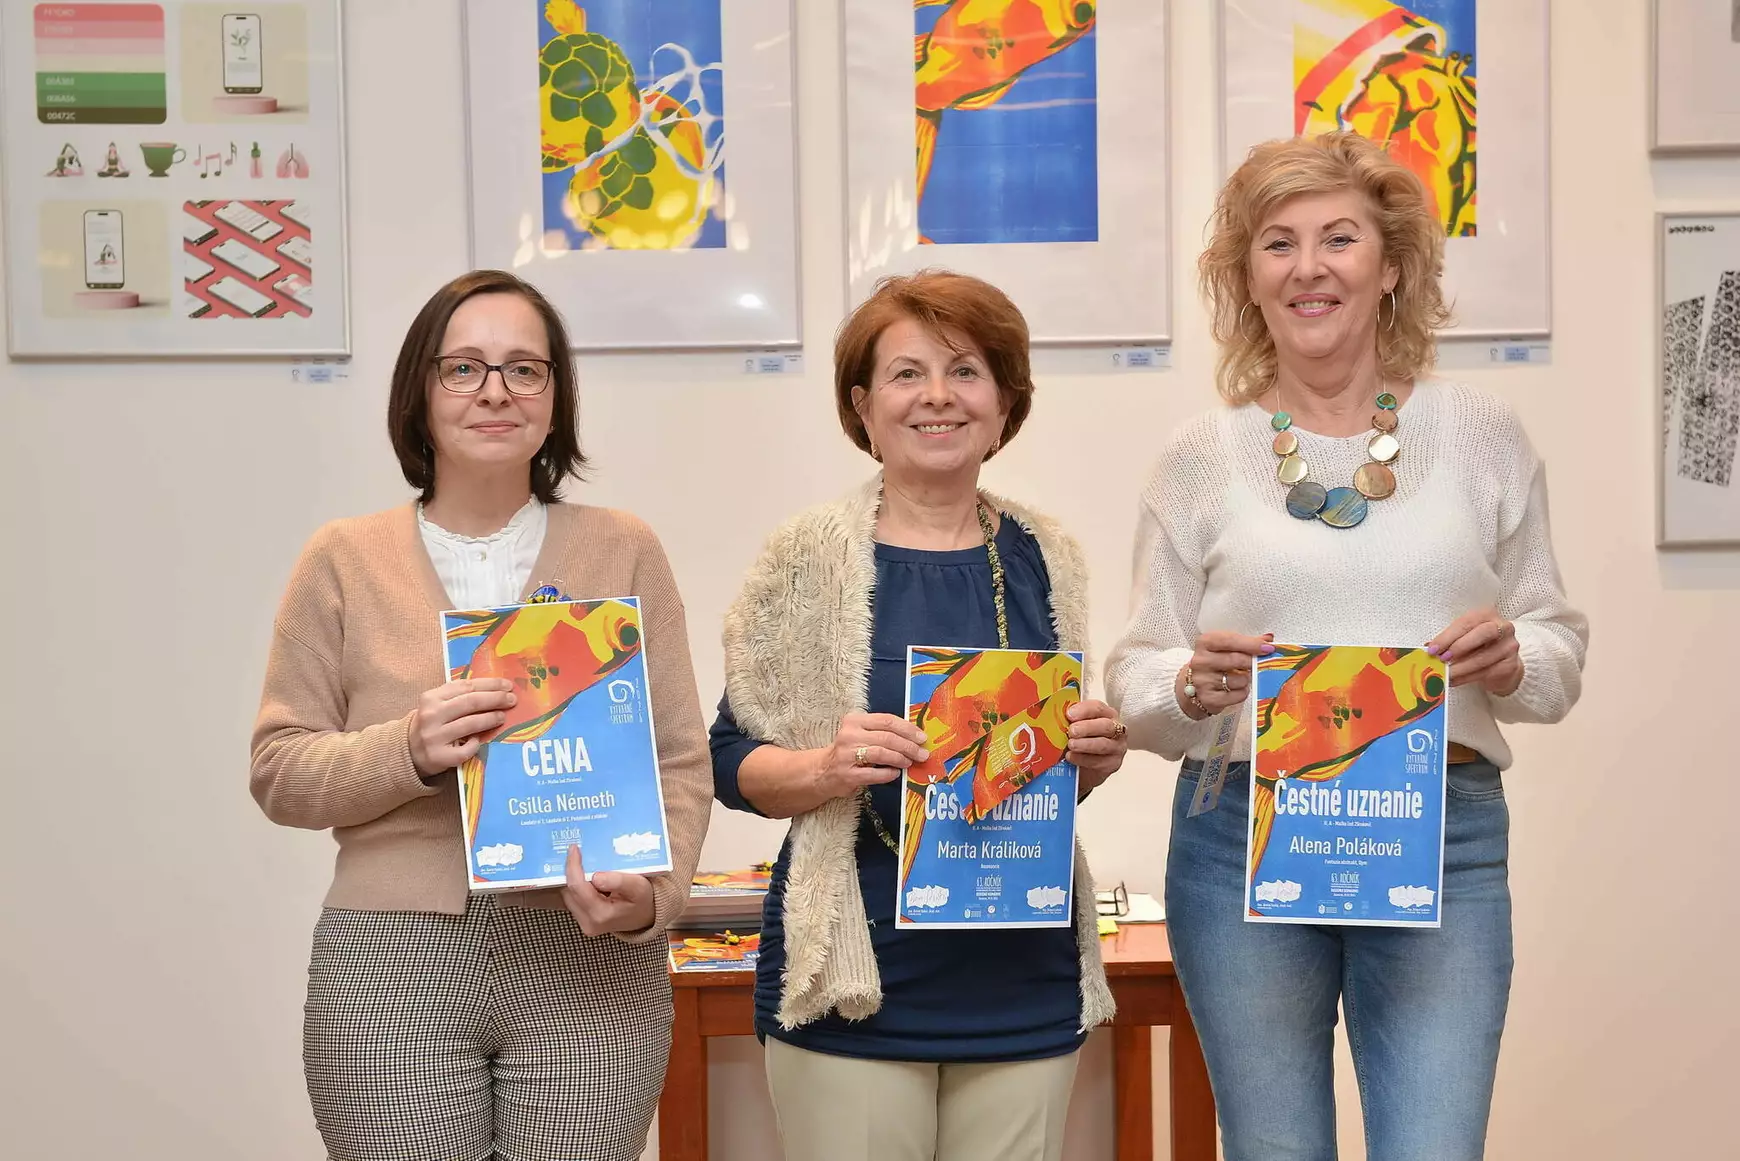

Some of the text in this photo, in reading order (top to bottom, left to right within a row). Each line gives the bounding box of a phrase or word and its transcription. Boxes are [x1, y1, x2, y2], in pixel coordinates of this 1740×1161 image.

[522, 737, 593, 776] CENA
[508, 791, 615, 816] Csilla Németh
[925, 775, 986, 821] Čes
[1274, 769, 1342, 817] Čestné
[1346, 782, 1423, 819] uznanie
[937, 839, 1041, 859] Marta Králiková
[1289, 835, 1402, 857] Alena Poláková
